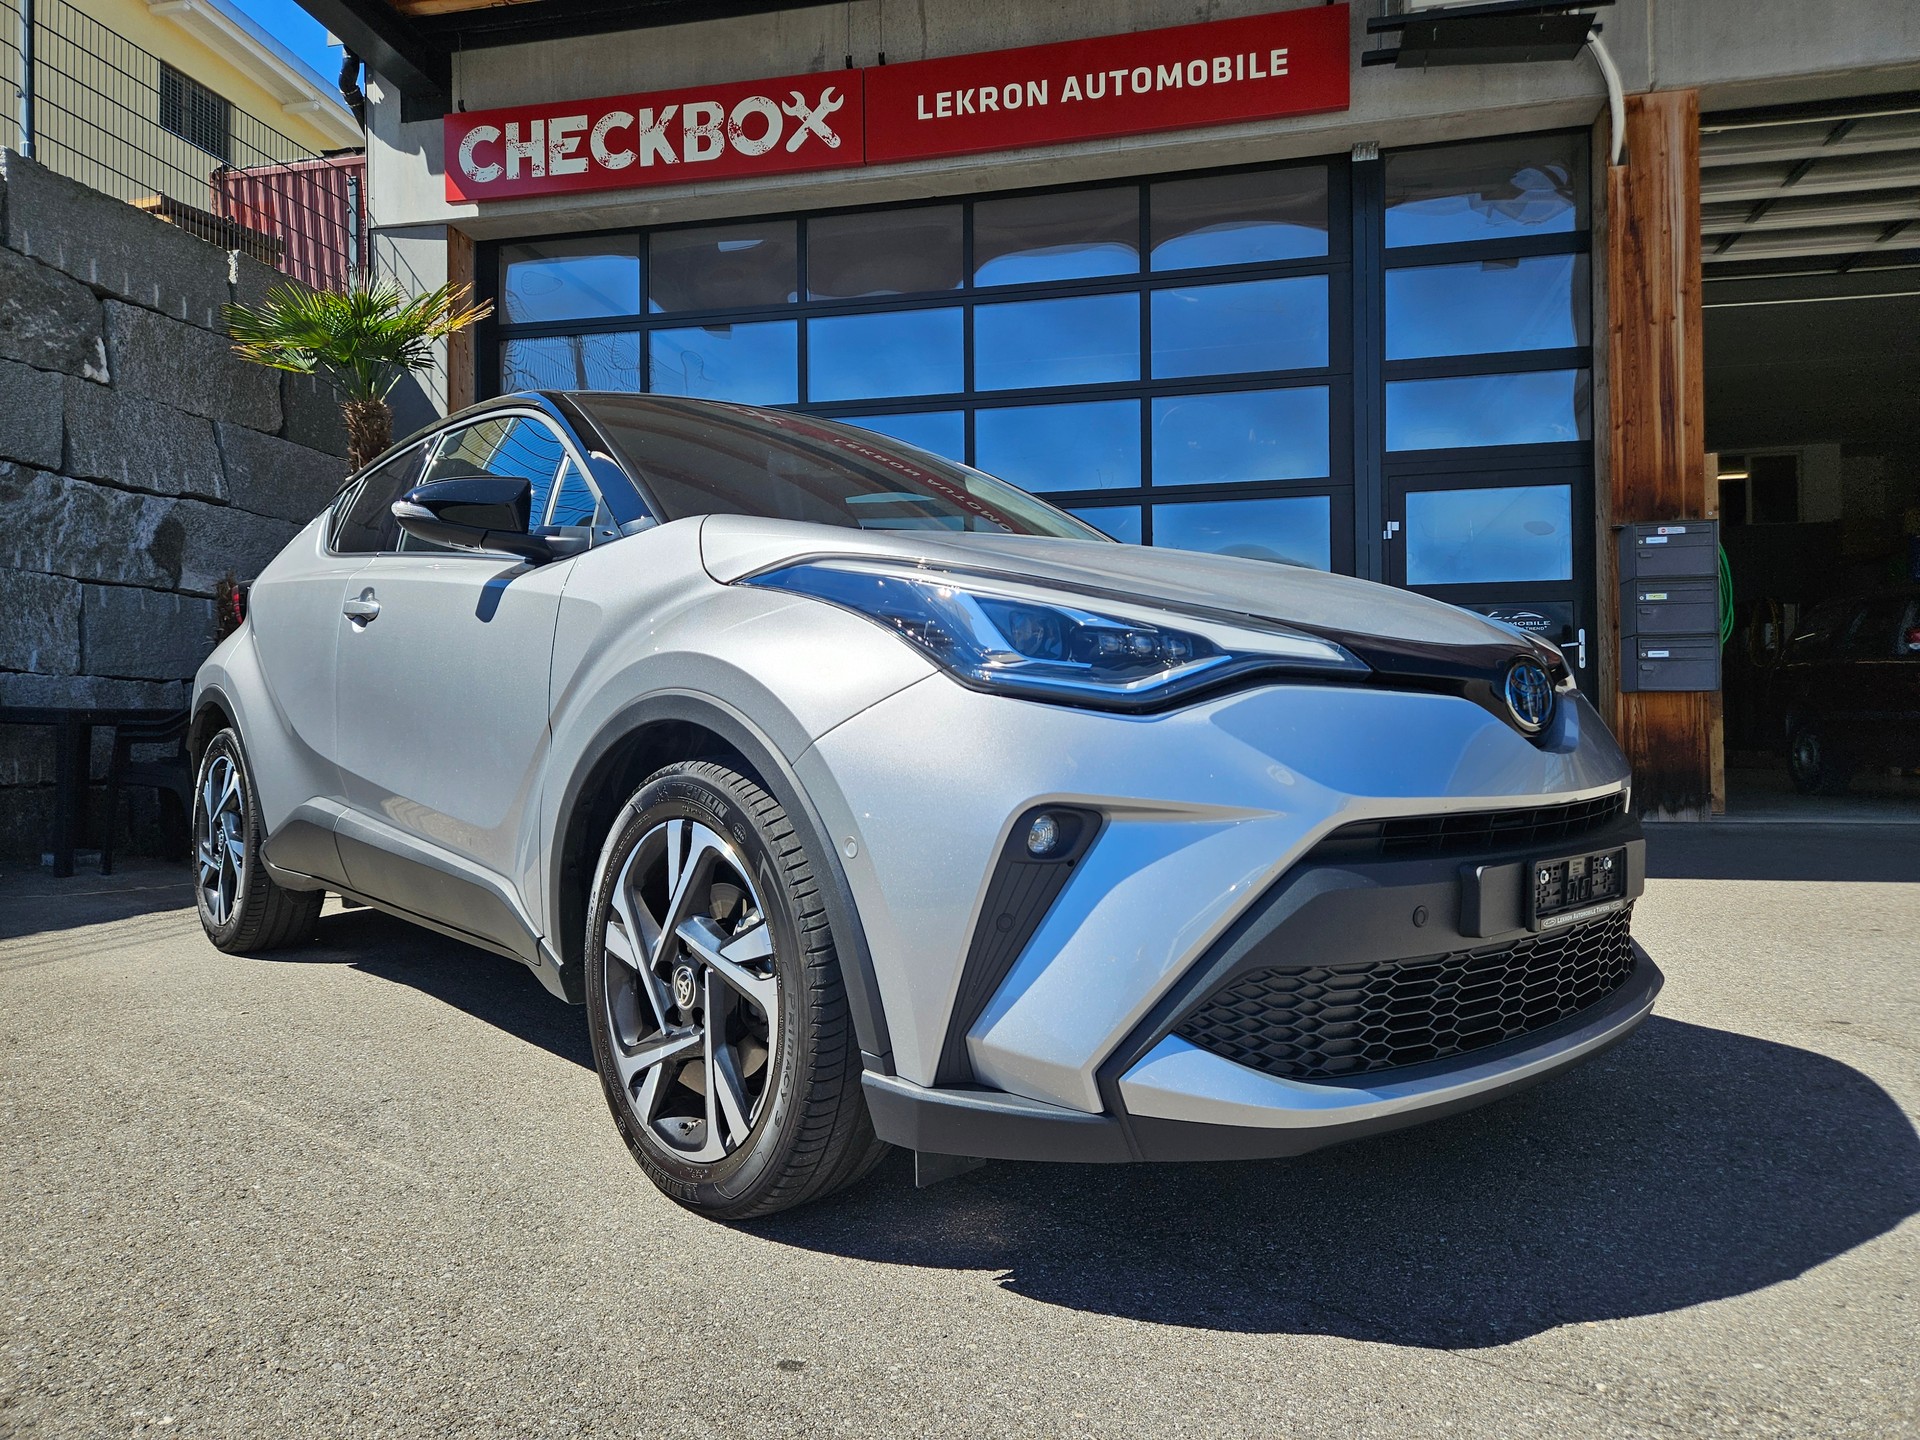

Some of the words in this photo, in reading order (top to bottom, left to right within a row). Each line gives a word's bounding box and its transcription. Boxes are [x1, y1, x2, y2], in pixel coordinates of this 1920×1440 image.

[917, 79, 1048, 121] LEKRON
[1060, 48, 1289, 104] AUTOMOBILE
[458, 86, 845, 183] CHECKBOX
[780, 992, 796, 1105] PRIMACY
